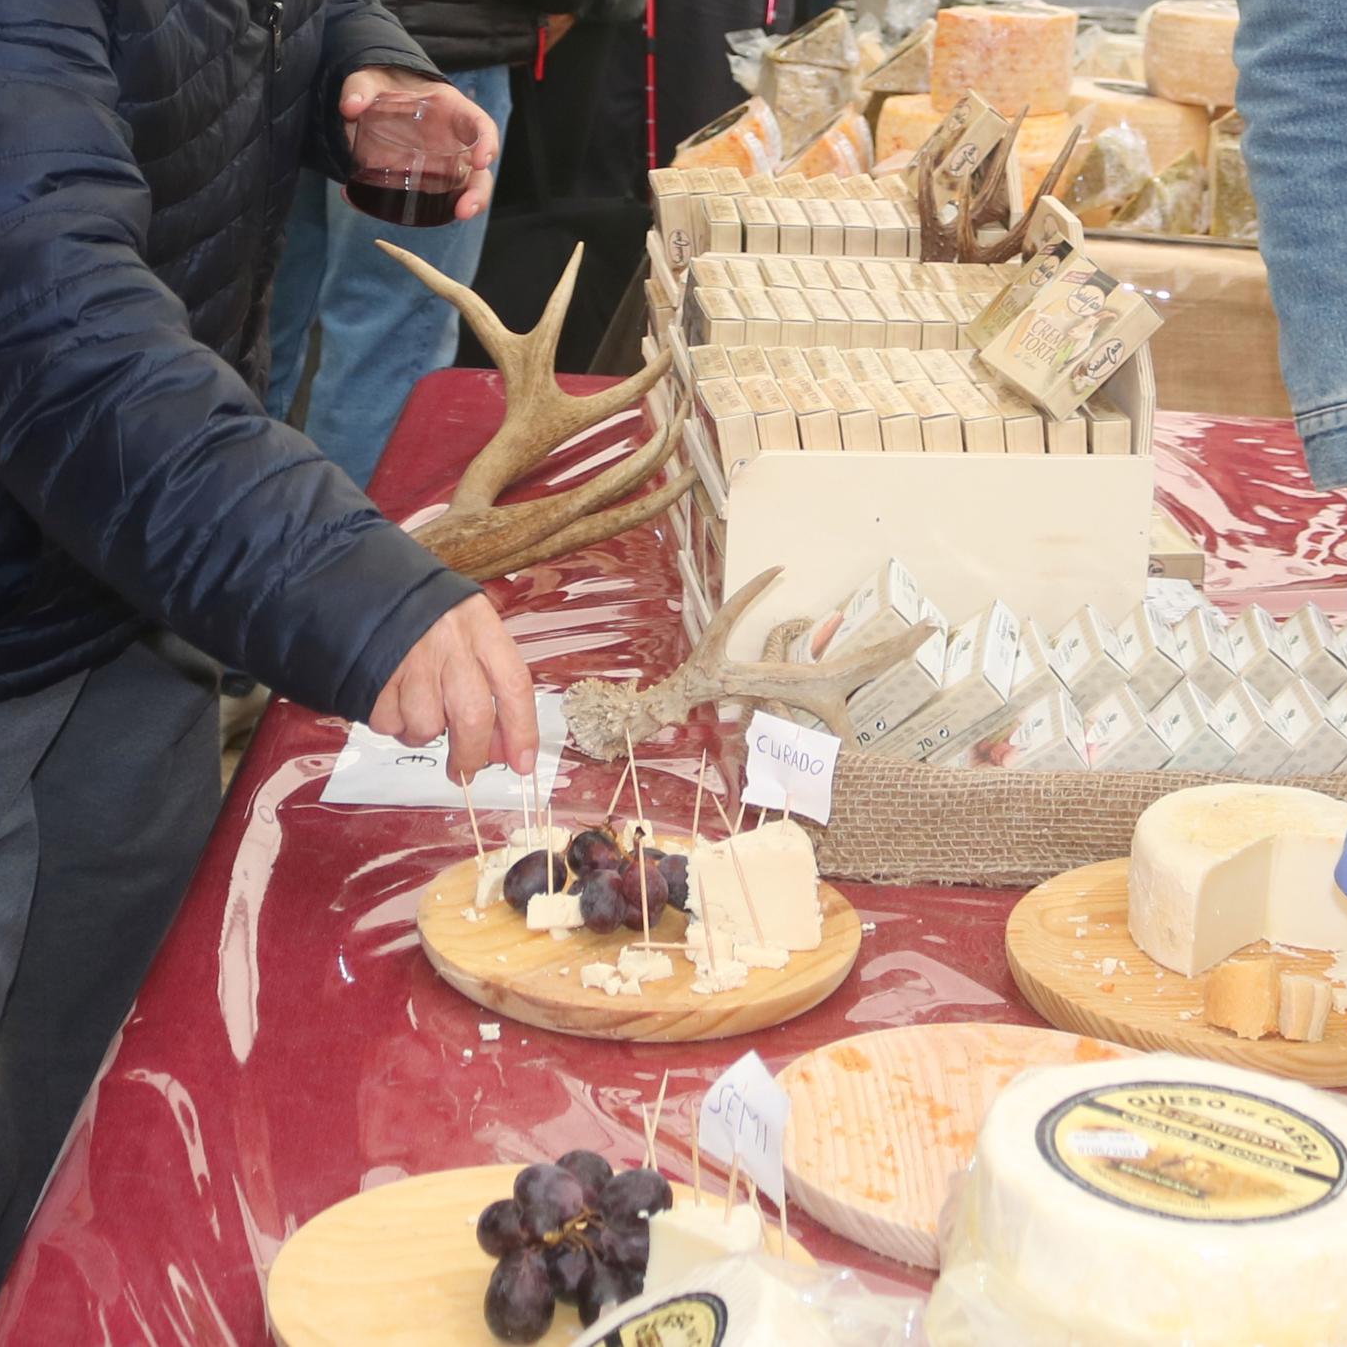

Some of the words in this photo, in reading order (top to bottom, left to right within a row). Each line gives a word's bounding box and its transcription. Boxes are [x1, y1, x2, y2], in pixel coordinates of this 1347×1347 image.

[756, 734, 825, 776] CURADO
[708, 1083, 768, 1154] SEMI
[1127, 1094, 1227, 1109] QUESO
